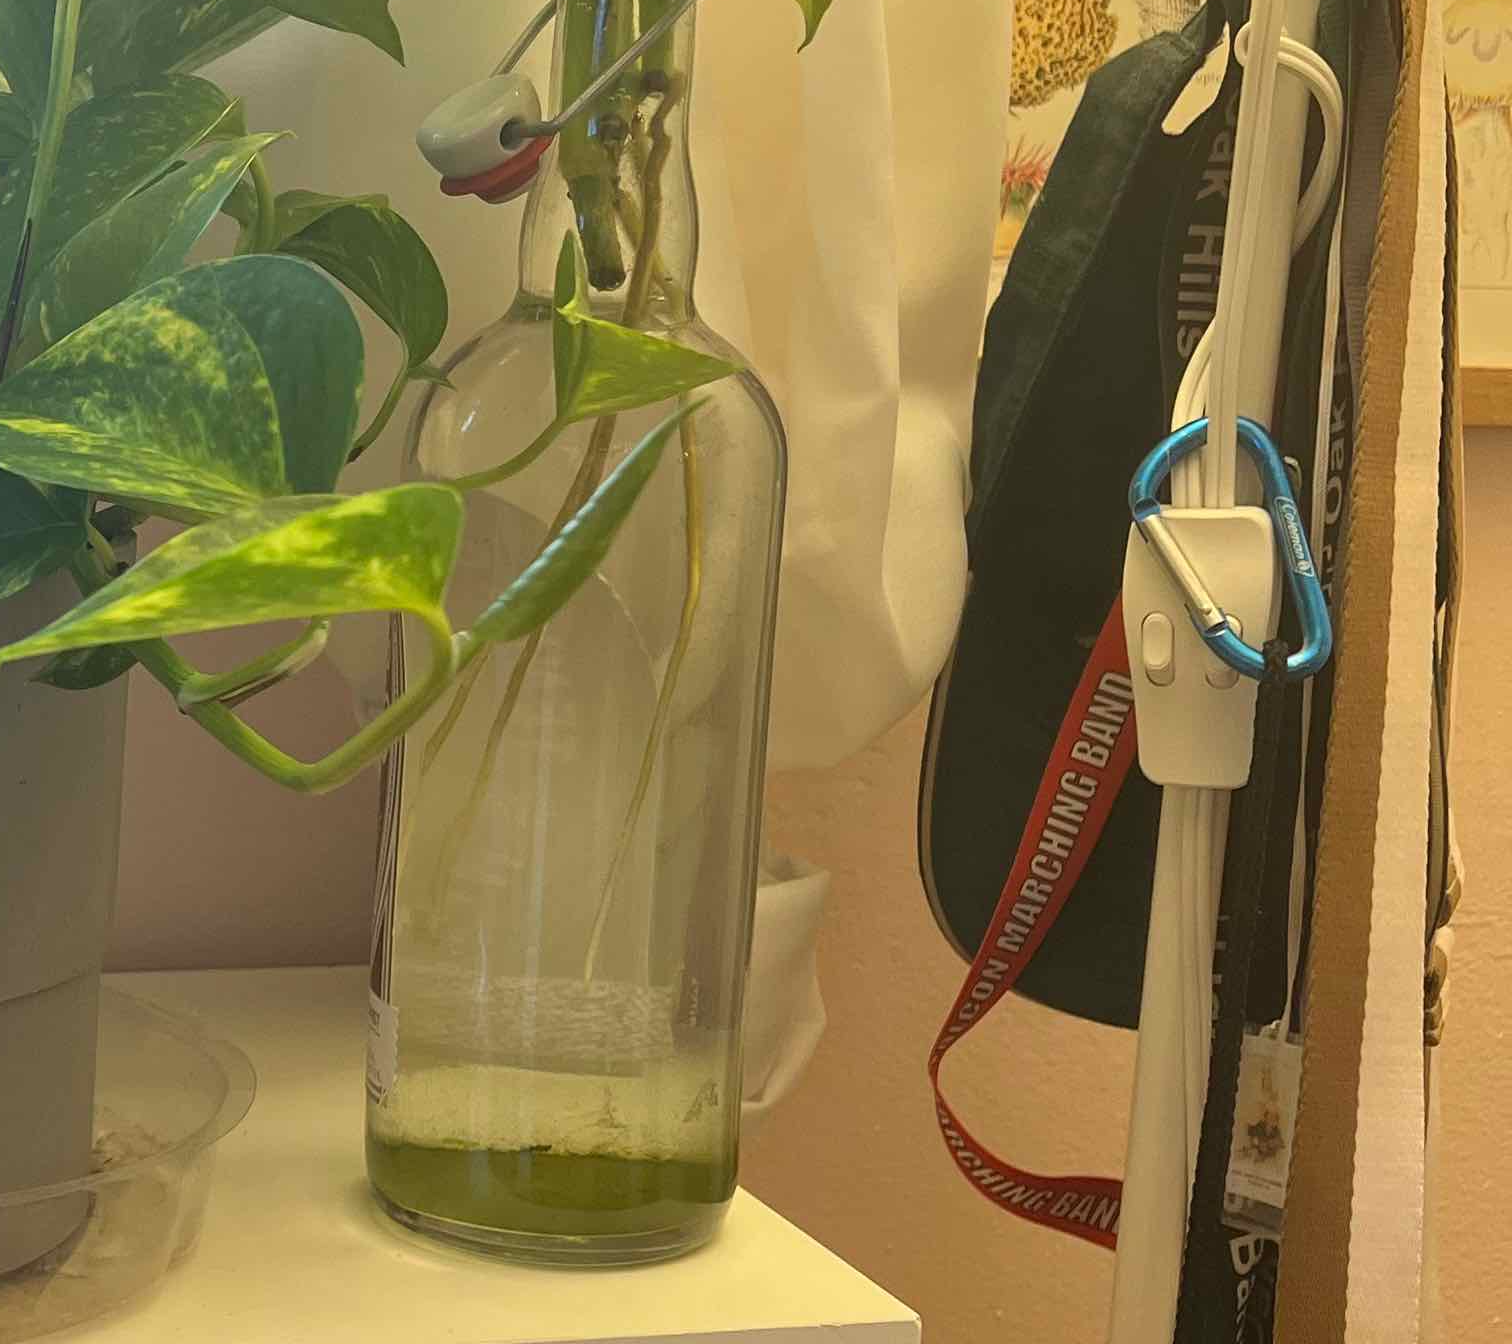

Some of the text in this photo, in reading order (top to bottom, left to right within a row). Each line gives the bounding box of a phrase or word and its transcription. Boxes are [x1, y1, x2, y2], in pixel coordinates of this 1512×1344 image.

[996, 770, 1099, 954] MARCHING
[1070, 671, 1135, 770] BAND
[1050, 1191, 1120, 1234] BAN
